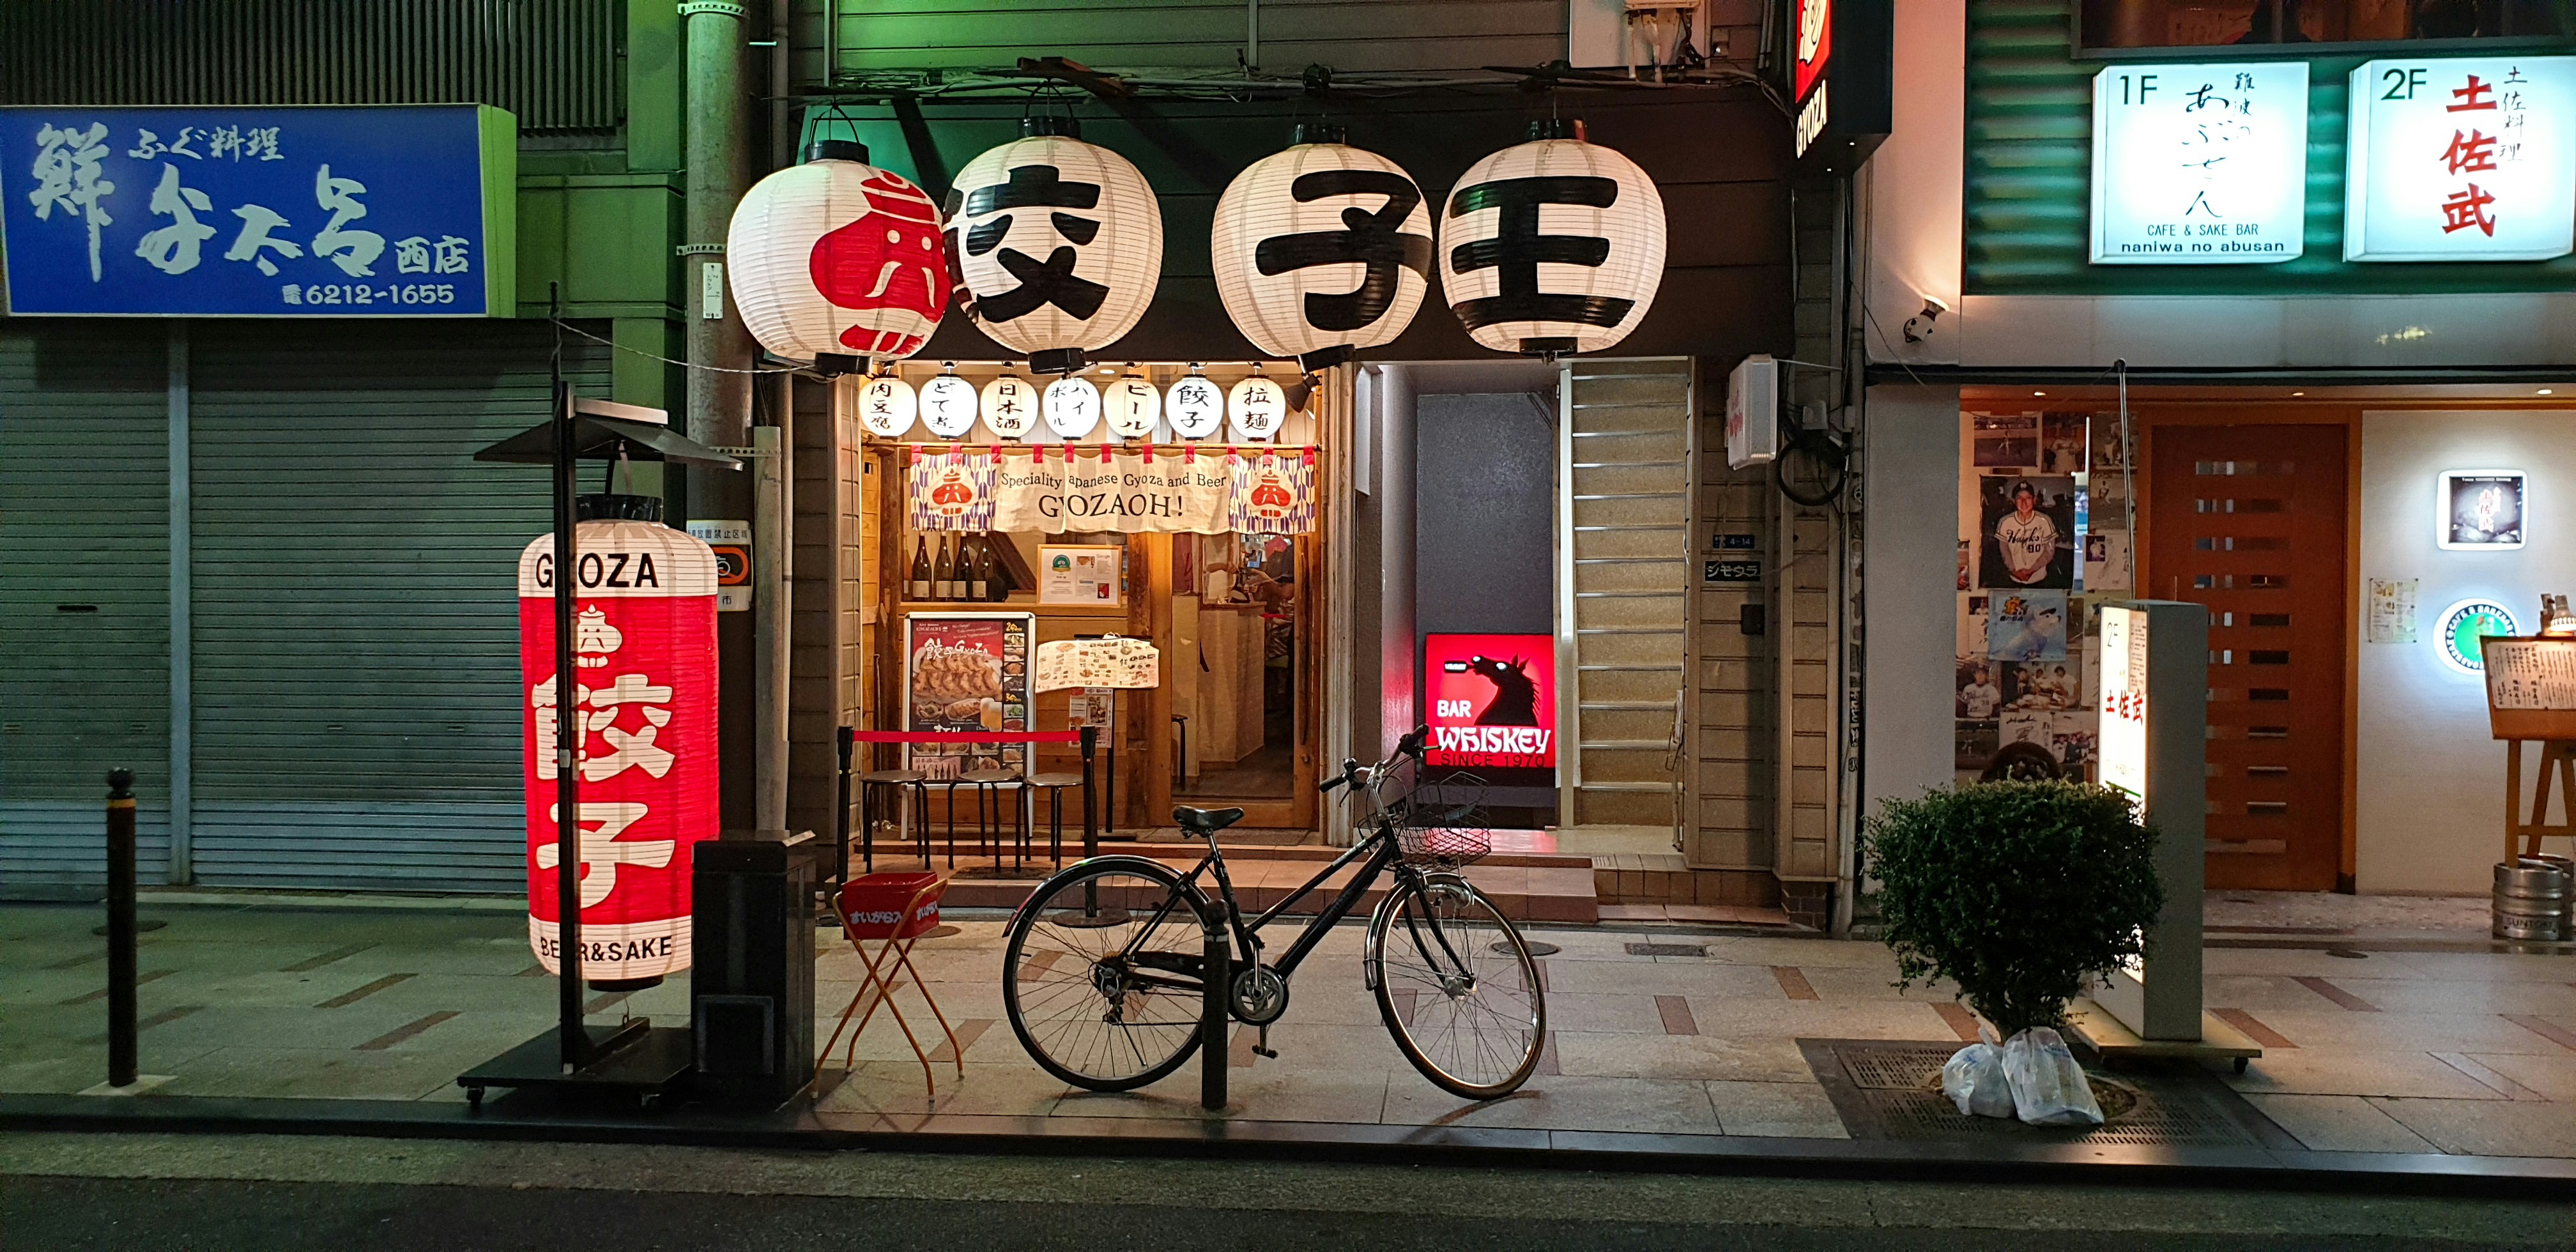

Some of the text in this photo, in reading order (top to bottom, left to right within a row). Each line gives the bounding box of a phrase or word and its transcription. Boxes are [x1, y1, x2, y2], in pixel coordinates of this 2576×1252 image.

[2119, 75, 2158, 105] 1F
[2380, 68, 2427, 101] 2F
[1797, 79, 1828, 159] GYOZA
[2500, 66, 2528, 163] 土佐料理
[128, 125, 285, 164] ふぐ料理
[2439, 73, 2499, 238] 土佐武
[2121, 240, 2285, 253] naniwa no abusan
[2147, 224, 2258, 237] CAFE & SAKE BAR
[395, 234, 469, 274] 西店
[995, 384, 1022, 429] 日本酒
[1119, 384, 1153, 431] ビール
[1176, 385, 1209, 428] 餃子
[1001, 472, 1227, 490] Speciality apanese Gyoza and Beer
[536, 553, 659, 589] GOZA
[924, 637, 956, 660] 餃子
[1437, 699, 1471, 717] BAR
[2106, 688, 2143, 727] 土佐武
[1441, 753, 1545, 767] SINCE 1970
[532, 673, 675, 909] 餃子
[540, 935, 673, 961] BER&SAKE
